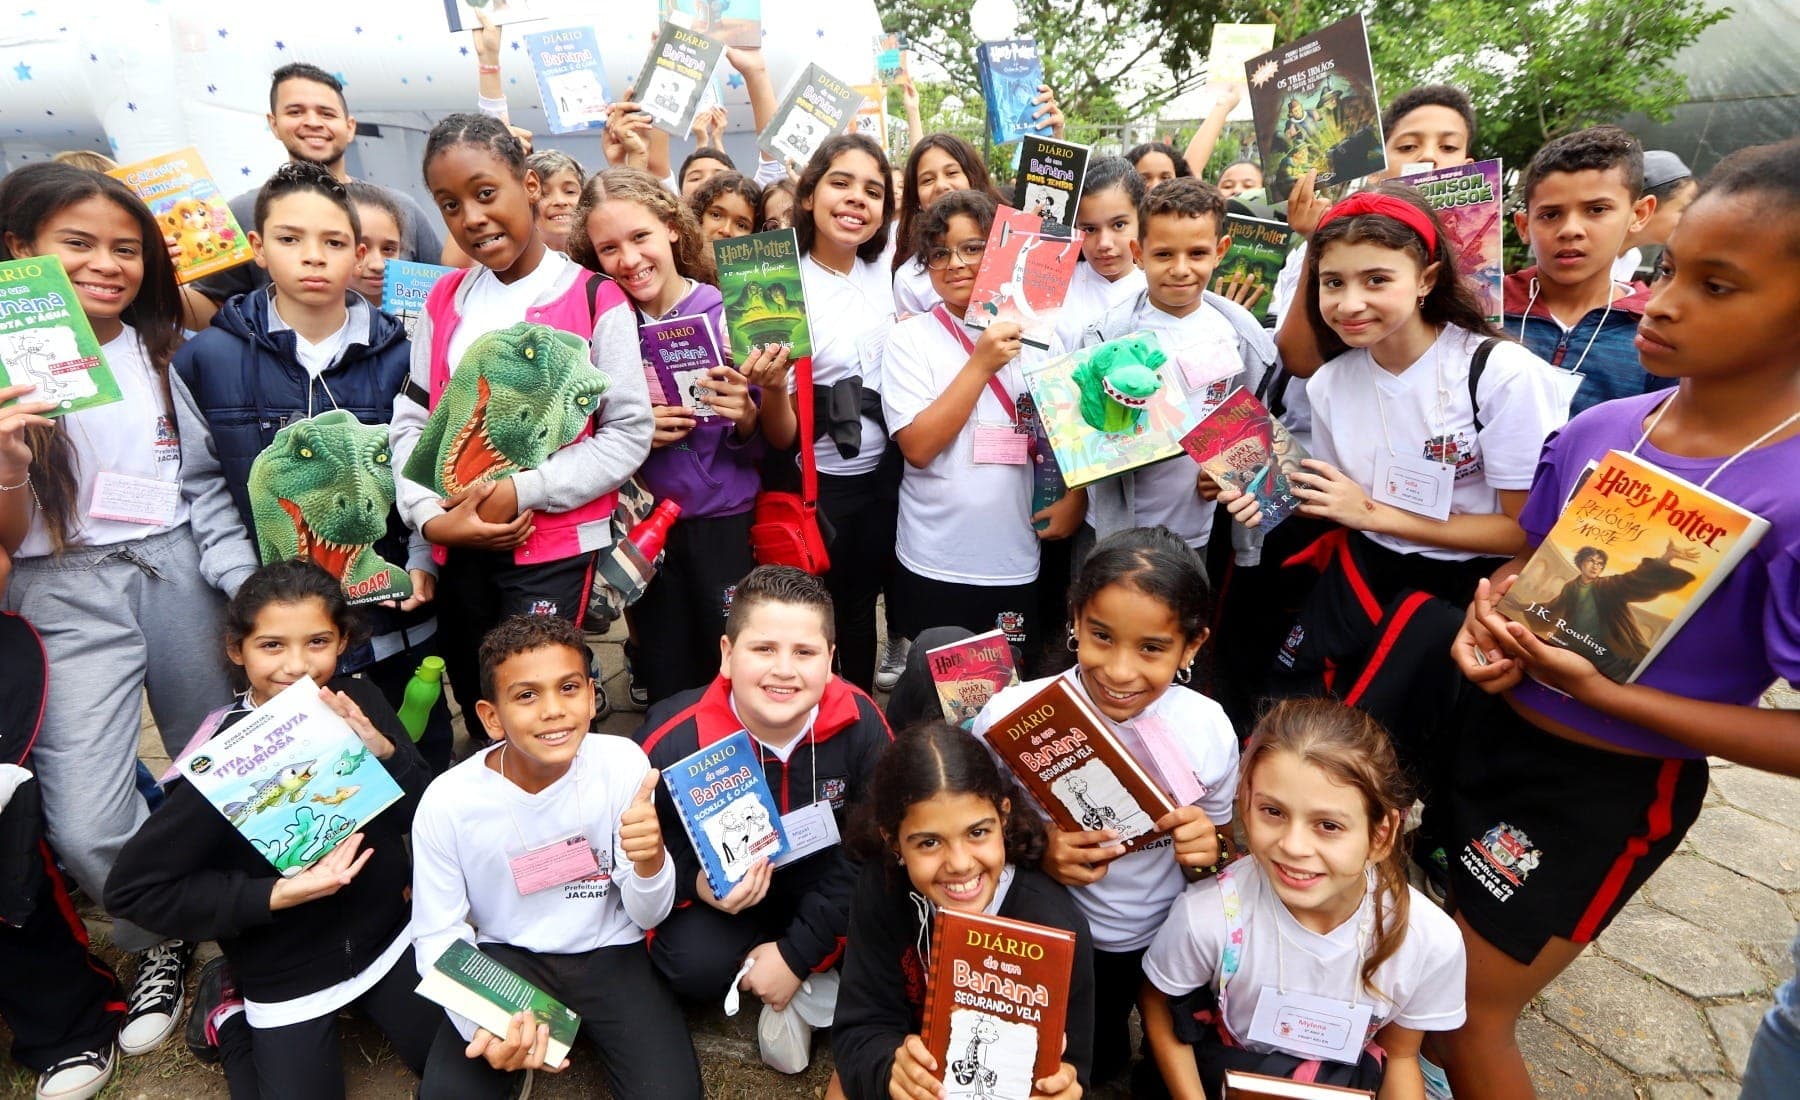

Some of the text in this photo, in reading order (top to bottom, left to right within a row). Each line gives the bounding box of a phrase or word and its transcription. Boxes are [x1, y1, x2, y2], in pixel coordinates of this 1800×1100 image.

[674, 30, 710, 50] DIÁRIO
[661, 43, 706, 72] Banana
[818, 75, 850, 99] DIÁRIO
[1276, 78, 1288, 90] OS
[1287, 69, 1307, 85] TRÊS
[802, 84, 843, 121] Banana
[1037, 143, 1073, 159] DIÁRIO
[1030, 158, 1074, 182] Banana
[1228, 221, 1288, 247] Harry Potter
[719, 238, 795, 266] Harry Potter
[0, 264, 42, 283] RIO
[395, 282, 429, 300] Bana
[0, 292, 66, 319] nana
[658, 326, 695, 341] DIÁRIO
[658, 345, 708, 363] Banana
[1188, 398, 1260, 455] Harry Potter
[1594, 466, 1729, 553] Harry Potter
[1572, 522, 1622, 546] MORTE
[347, 568, 392, 598] ROAR!
[1524, 600, 1552, 624] J.K.
[1554, 618, 1608, 657] Rowling
[966, 645, 1006, 667] Potter
[253, 743, 264, 754] A
[263, 711, 309, 743] TRUTA
[1006, 703, 1056, 742] DIÁRIO
[1030, 727, 1057, 746] de um
[236, 734, 296, 778] CURIOSA
[687, 744, 737, 778] DIÁRIO
[1018, 727, 1089, 774] Banana
[1038, 744, 1096, 783] SEGURANDO VELA
[688, 765, 752, 807] Banana
[704, 765, 730, 783] de um
[693, 798, 726, 821] RODRICK
[740, 776, 759, 793] CARA
[1463, 845, 1515, 896] Prefeitura de
[564, 882, 603, 892] Prefeitura
[966, 928, 1045, 962] DIÁRIO
[982, 954, 1022, 976] de um
[952, 958, 1050, 1008] Banana
[953, 989, 1042, 1023] SEGURANDO VELA
